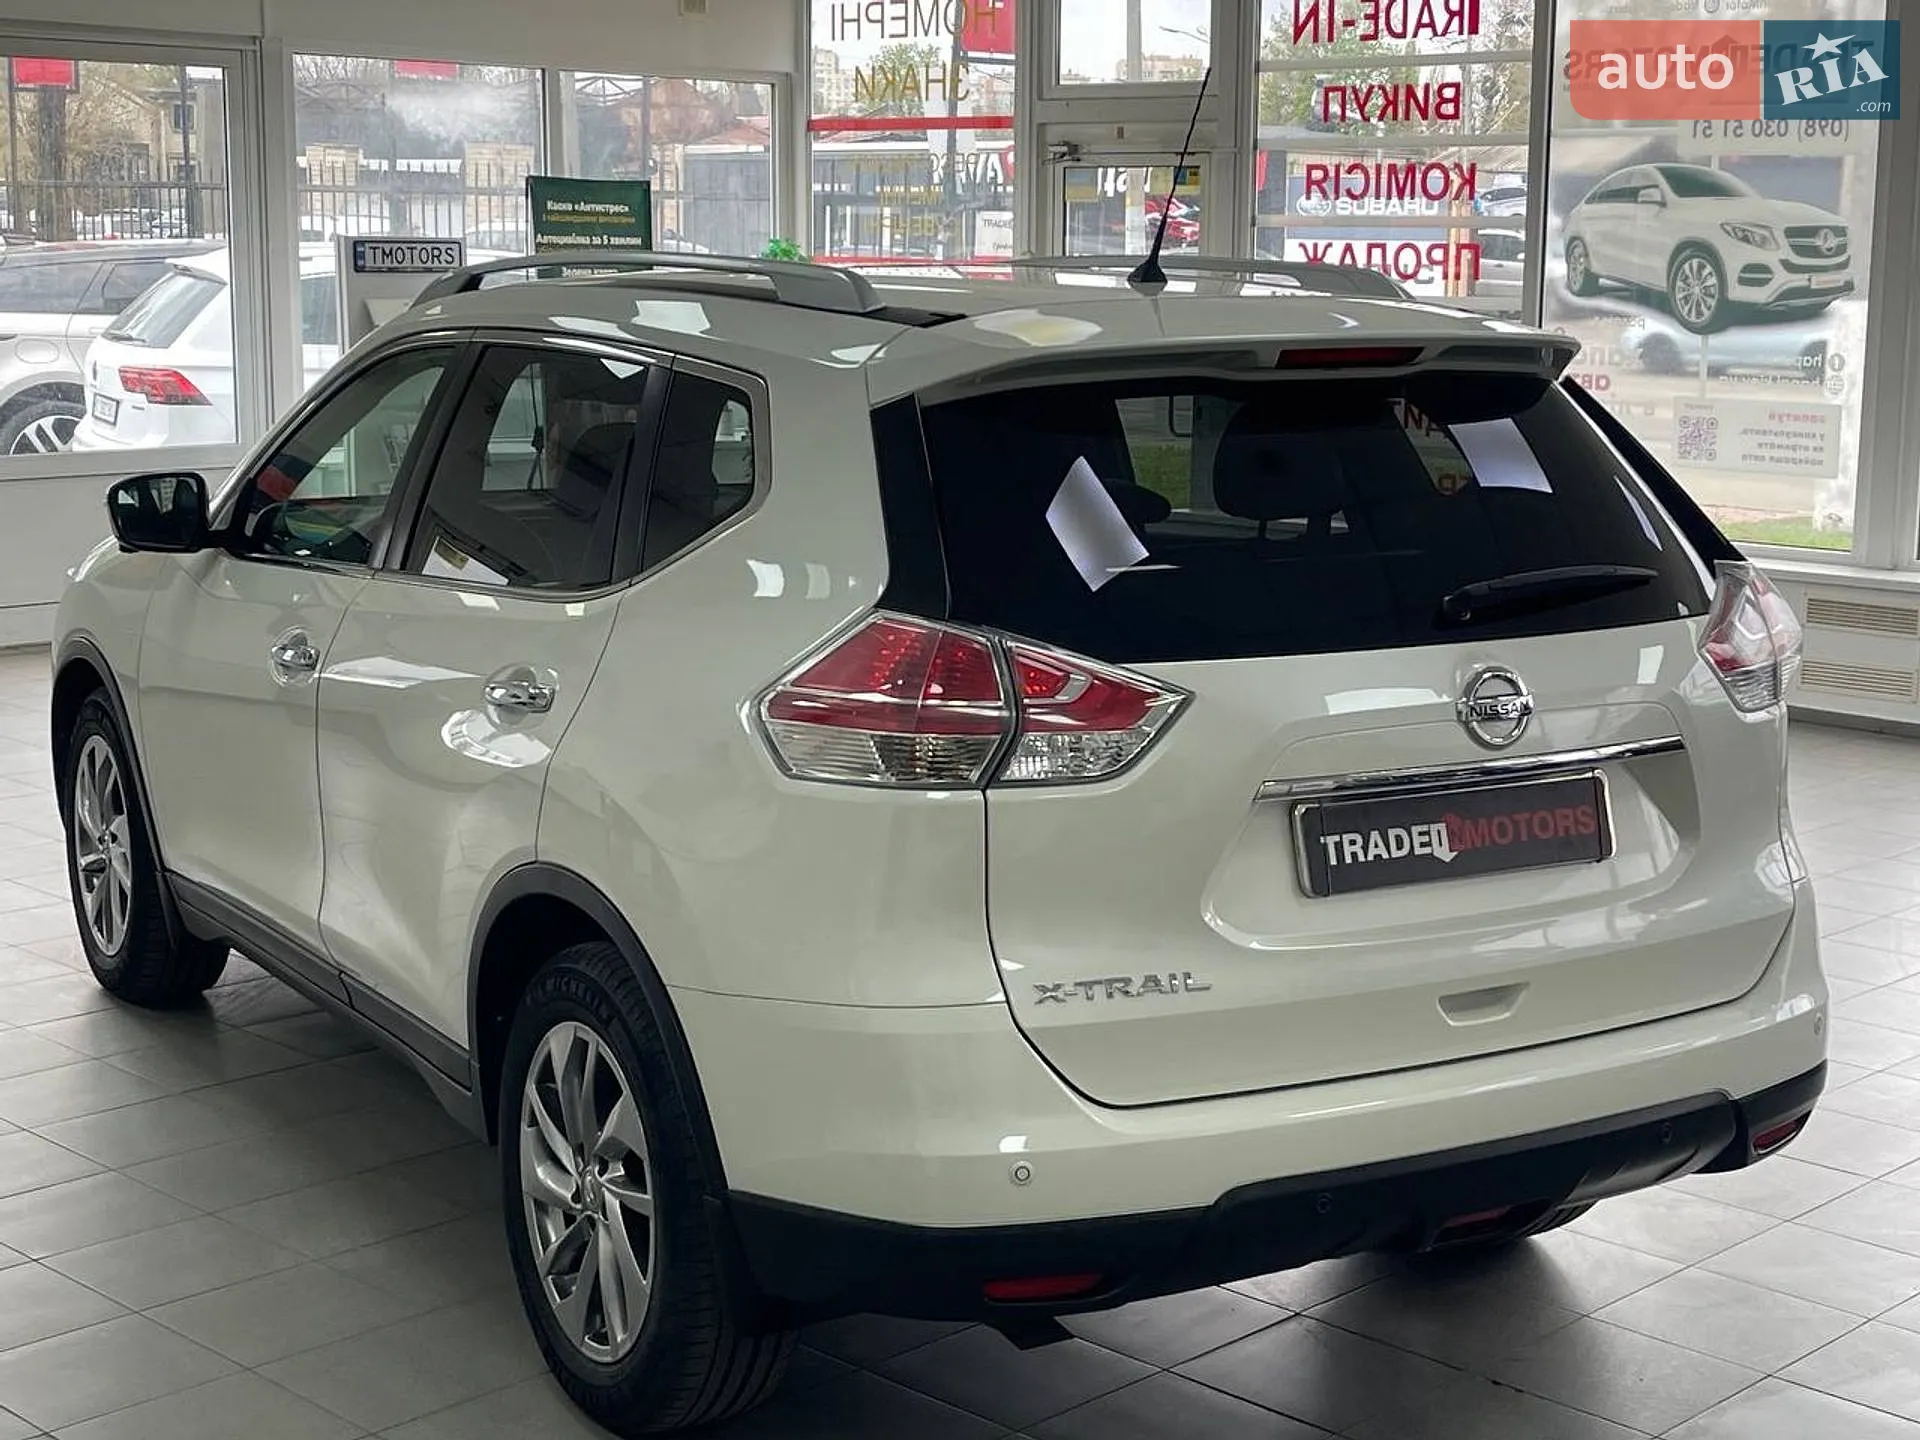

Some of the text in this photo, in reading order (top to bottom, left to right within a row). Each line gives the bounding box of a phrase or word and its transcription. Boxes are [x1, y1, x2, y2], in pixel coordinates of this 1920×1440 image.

[369, 246, 455, 264] TMOTORS
[1469, 700, 1532, 718] NISSAN
[1033, 971, 1212, 1005] X-TRAIL
